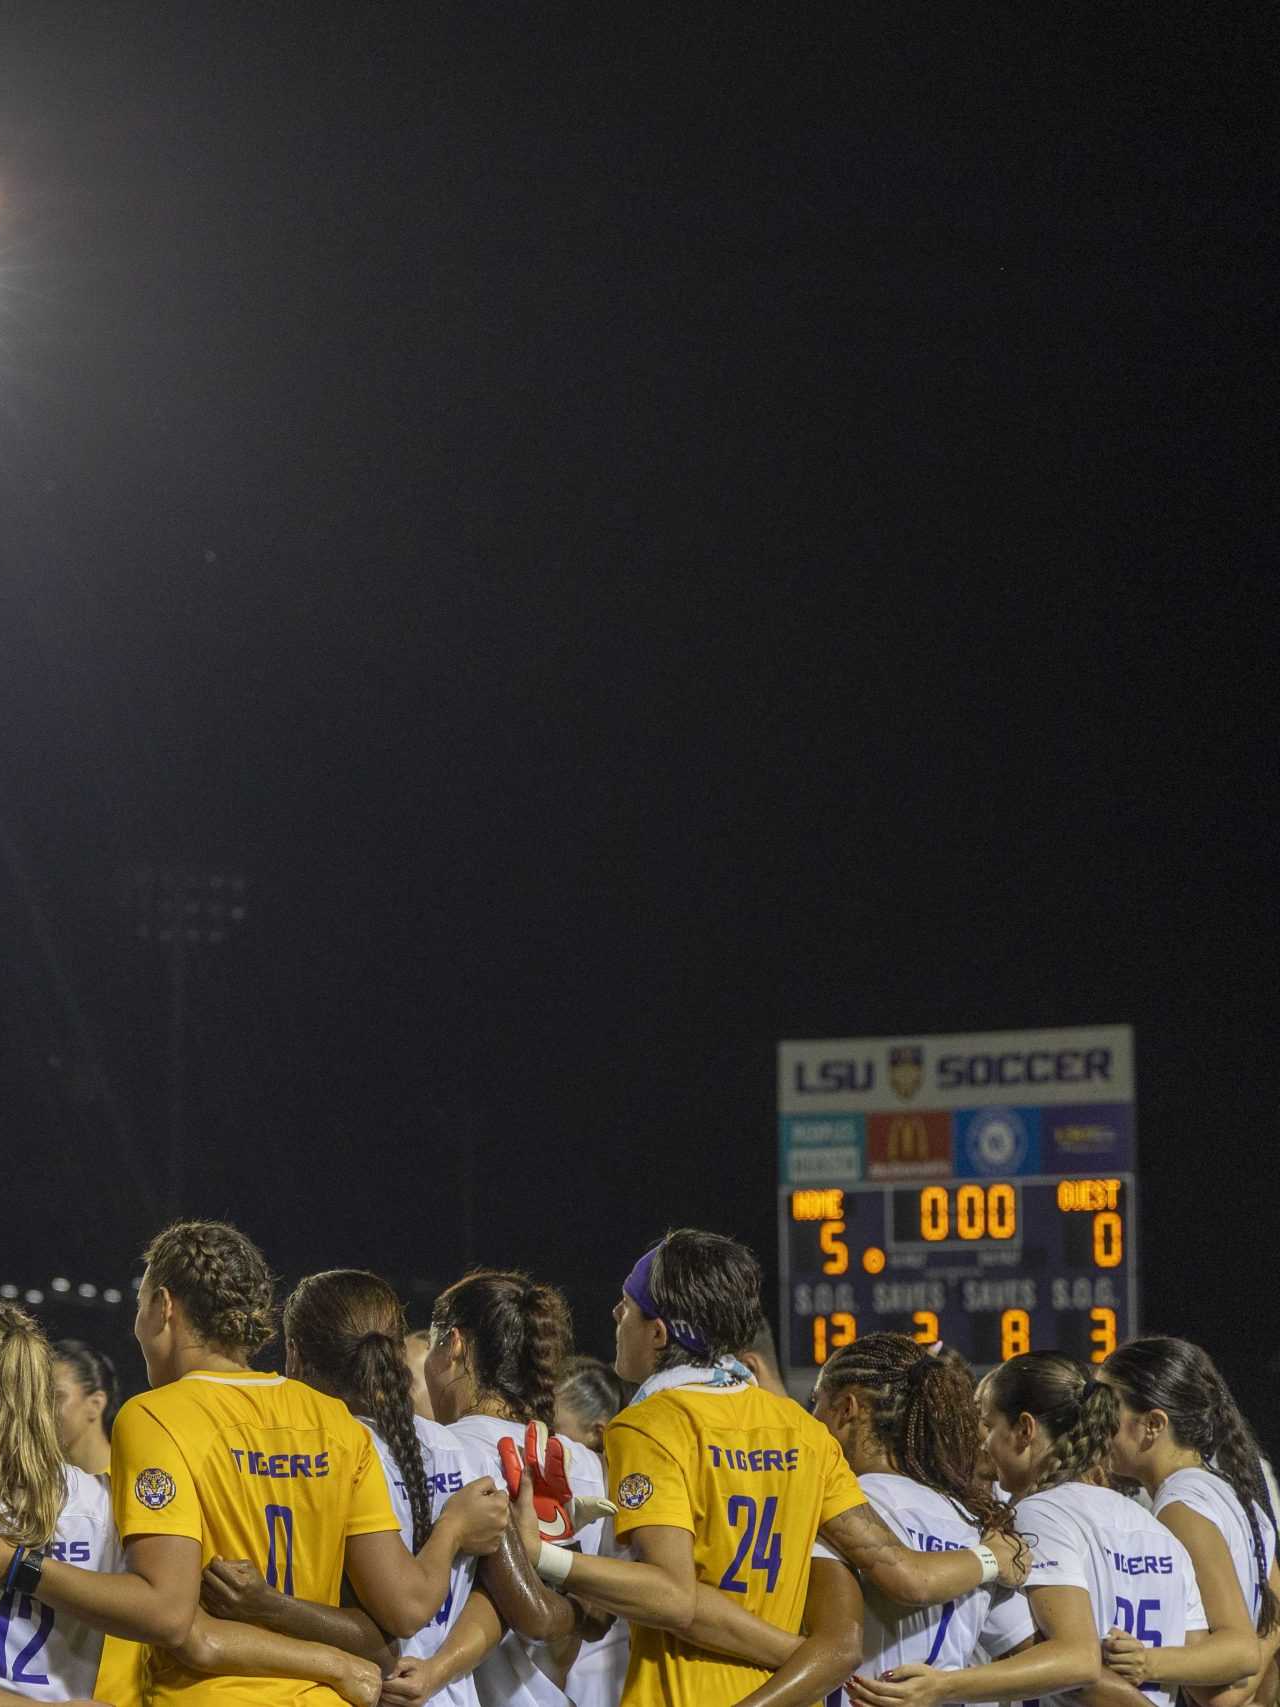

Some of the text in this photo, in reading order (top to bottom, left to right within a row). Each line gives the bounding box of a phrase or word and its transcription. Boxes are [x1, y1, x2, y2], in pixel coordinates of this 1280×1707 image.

[795, 1047, 1111, 1095] LSU SOCCER
[820, 1221, 849, 1276] 5
[1093, 1211, 1123, 1268] 0
[1001, 1308, 1030, 1362] 8
[1089, 1307, 1117, 1364] 3
[231, 1448, 329, 1479] TIGERS
[708, 1444, 800, 1472] TIGERS
[265, 1504, 295, 1597] 0
[719, 1495, 783, 1594] 24
